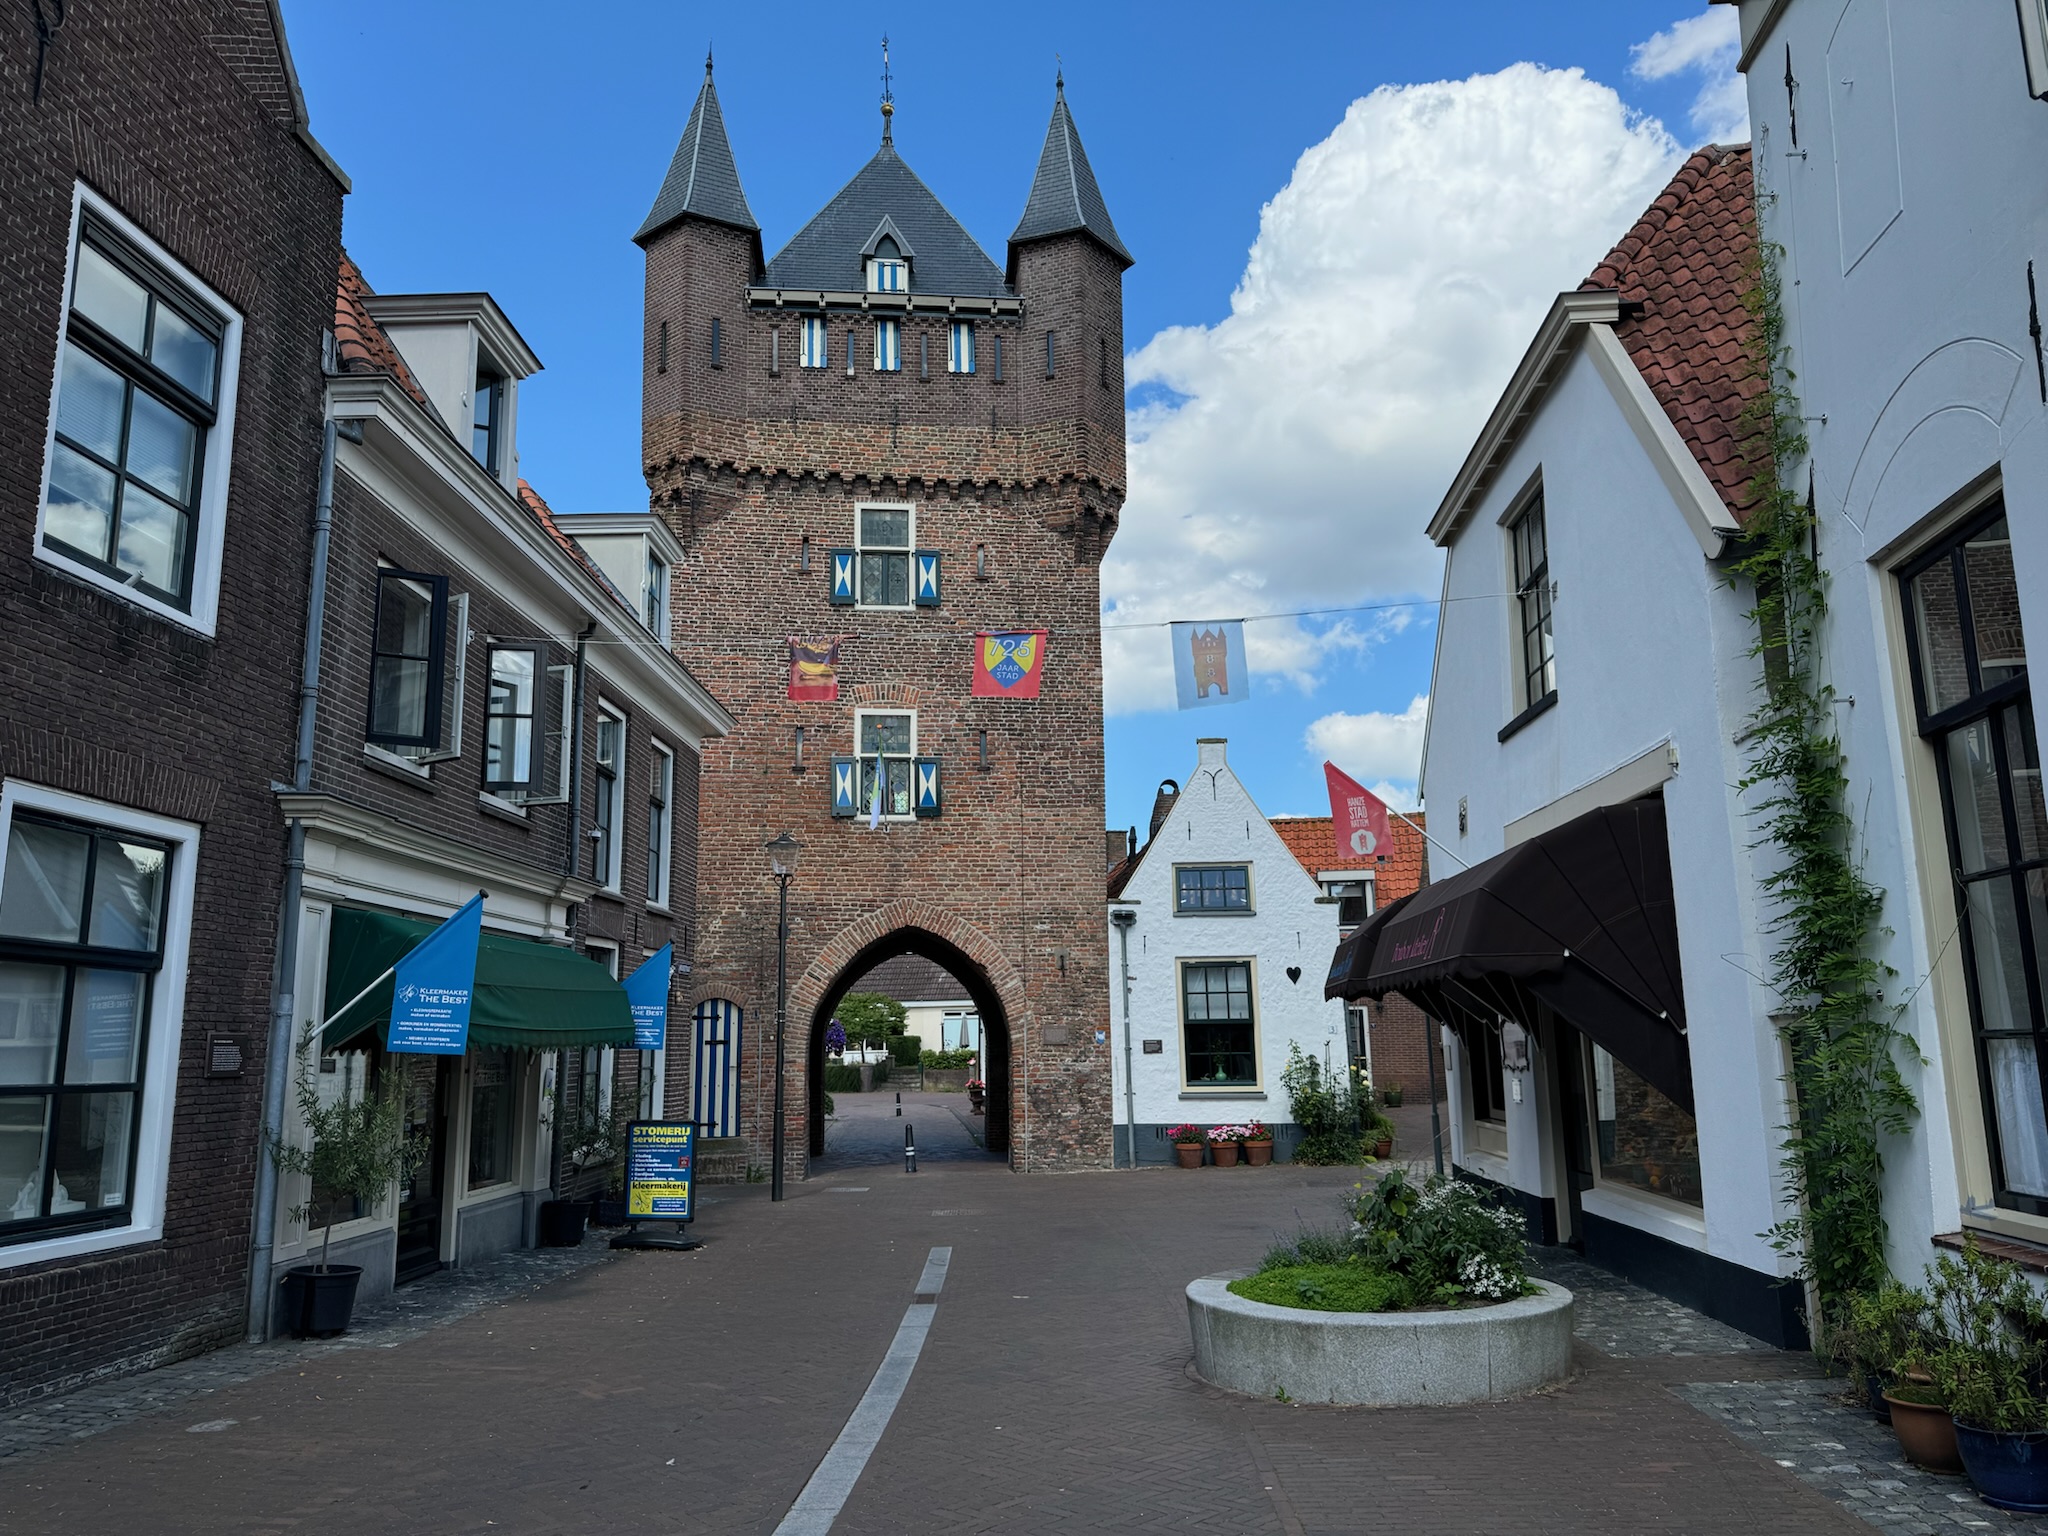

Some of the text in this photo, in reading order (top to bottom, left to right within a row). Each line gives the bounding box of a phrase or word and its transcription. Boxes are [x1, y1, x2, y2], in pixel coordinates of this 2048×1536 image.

[989, 638, 1031, 657] 725
[997, 664, 1019, 672] JAAR
[996, 672, 1019, 680] STAD
[1348, 806, 1368, 819] STAD
[420, 988, 469, 996] KLEERMAKER
[419, 994, 468, 1005] THE BEST
[633, 1126, 691, 1136] STOMERIJ
[633, 1135, 688, 1145] servicepunt
[632, 1182, 686, 1191] kleermakerij
